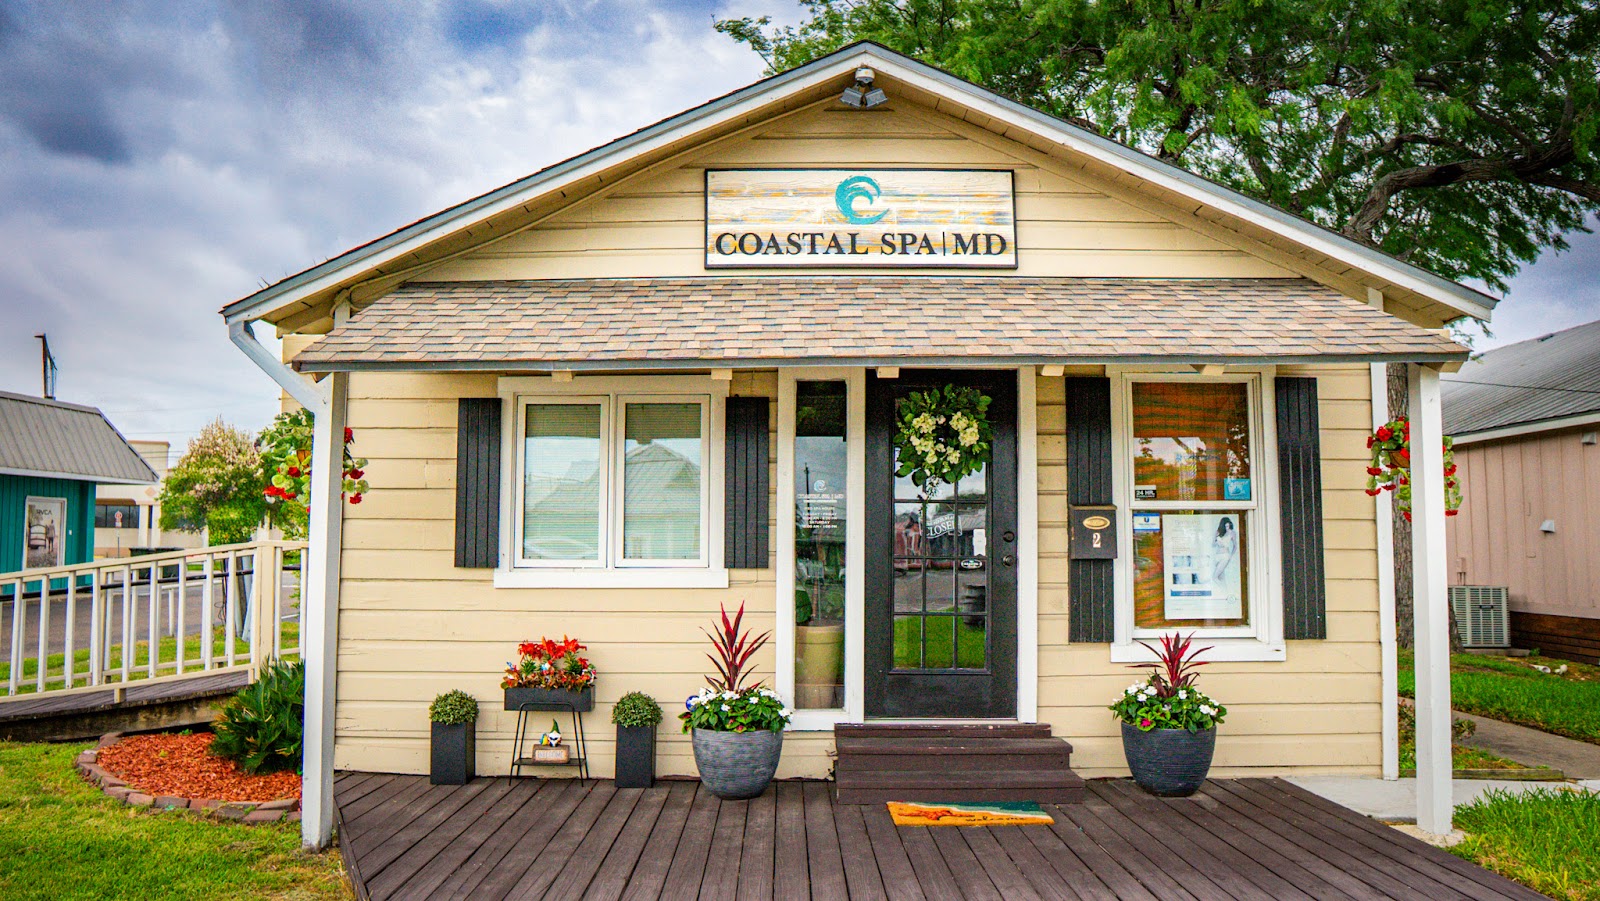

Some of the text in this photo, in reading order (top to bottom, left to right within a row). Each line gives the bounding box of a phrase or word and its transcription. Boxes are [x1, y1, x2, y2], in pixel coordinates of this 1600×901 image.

[715, 232, 1007, 256] COASTAL SPA MD
[1092, 532, 1101, 548] 2
